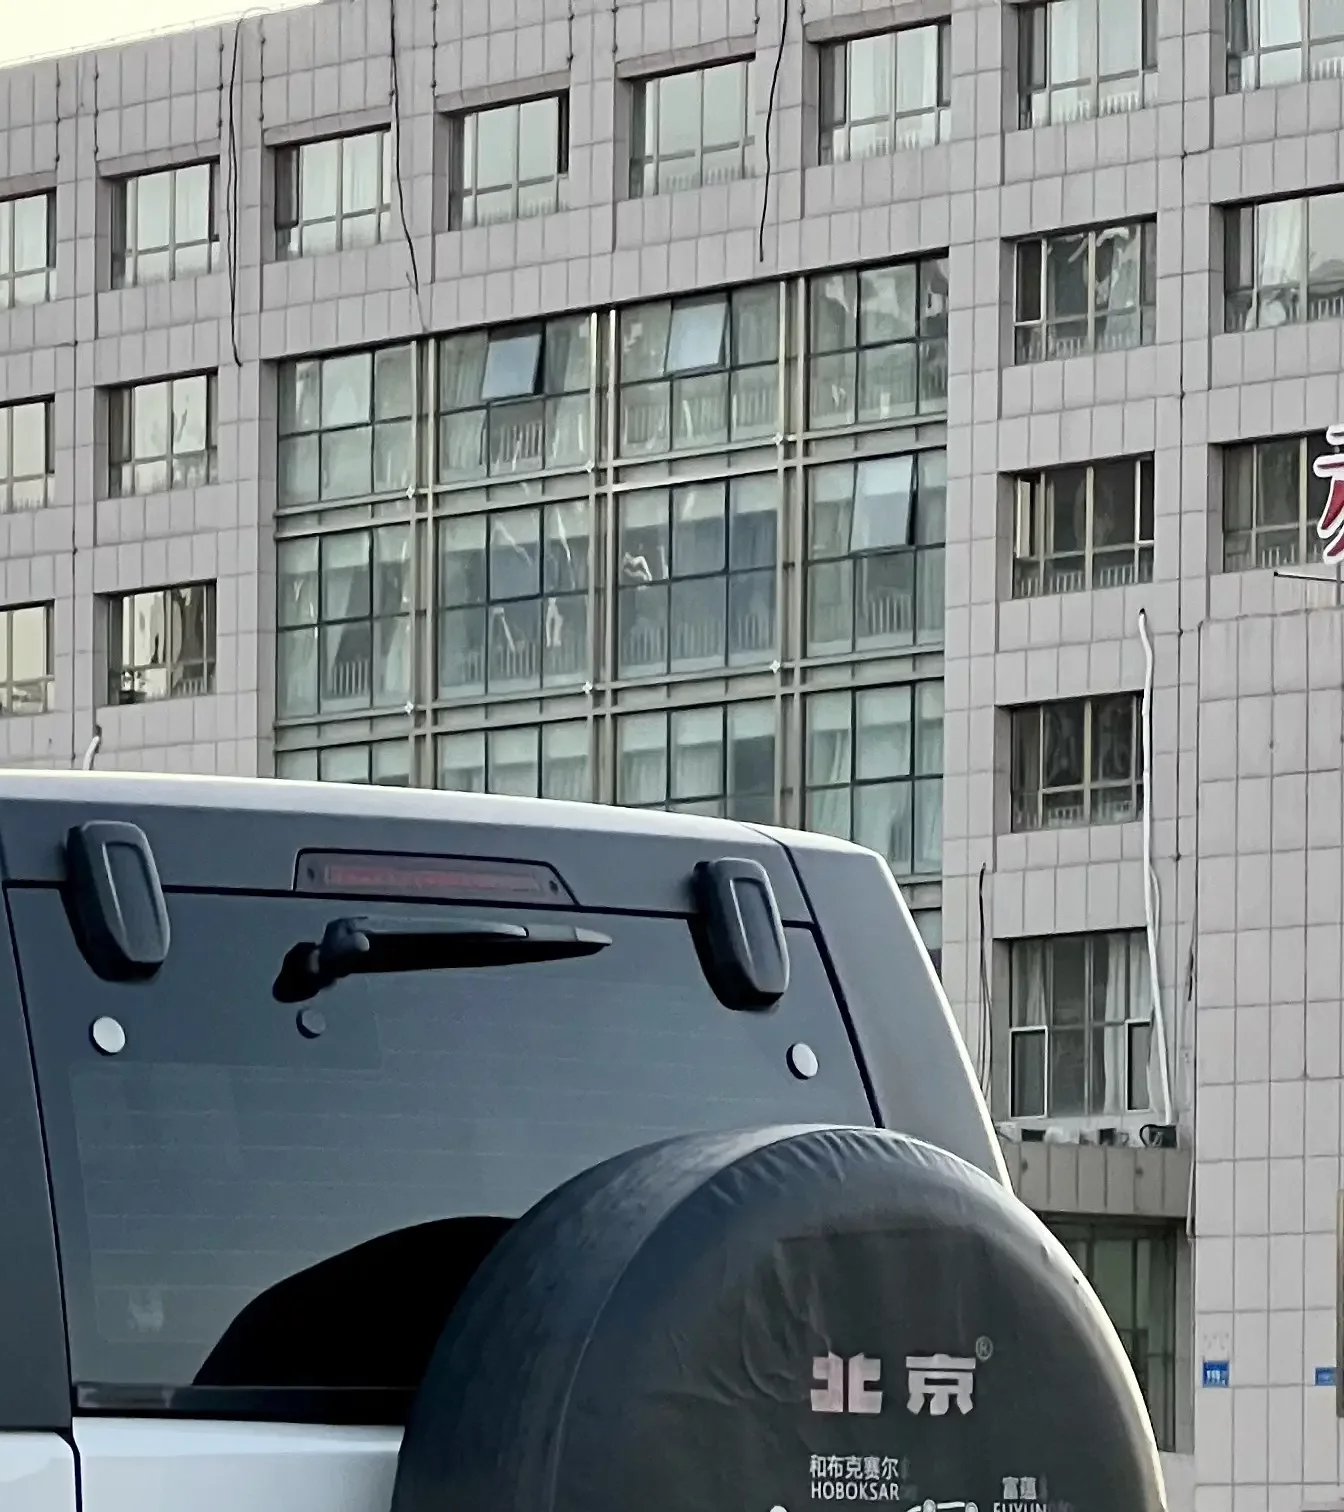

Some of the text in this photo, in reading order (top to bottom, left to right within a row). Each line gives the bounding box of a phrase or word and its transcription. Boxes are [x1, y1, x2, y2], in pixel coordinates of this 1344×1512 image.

[810, 1351, 977, 1416] 北京
[809, 1454, 900, 1481] 和布克赛尔
[811, 1481, 900, 1501] HOBOKSAR
